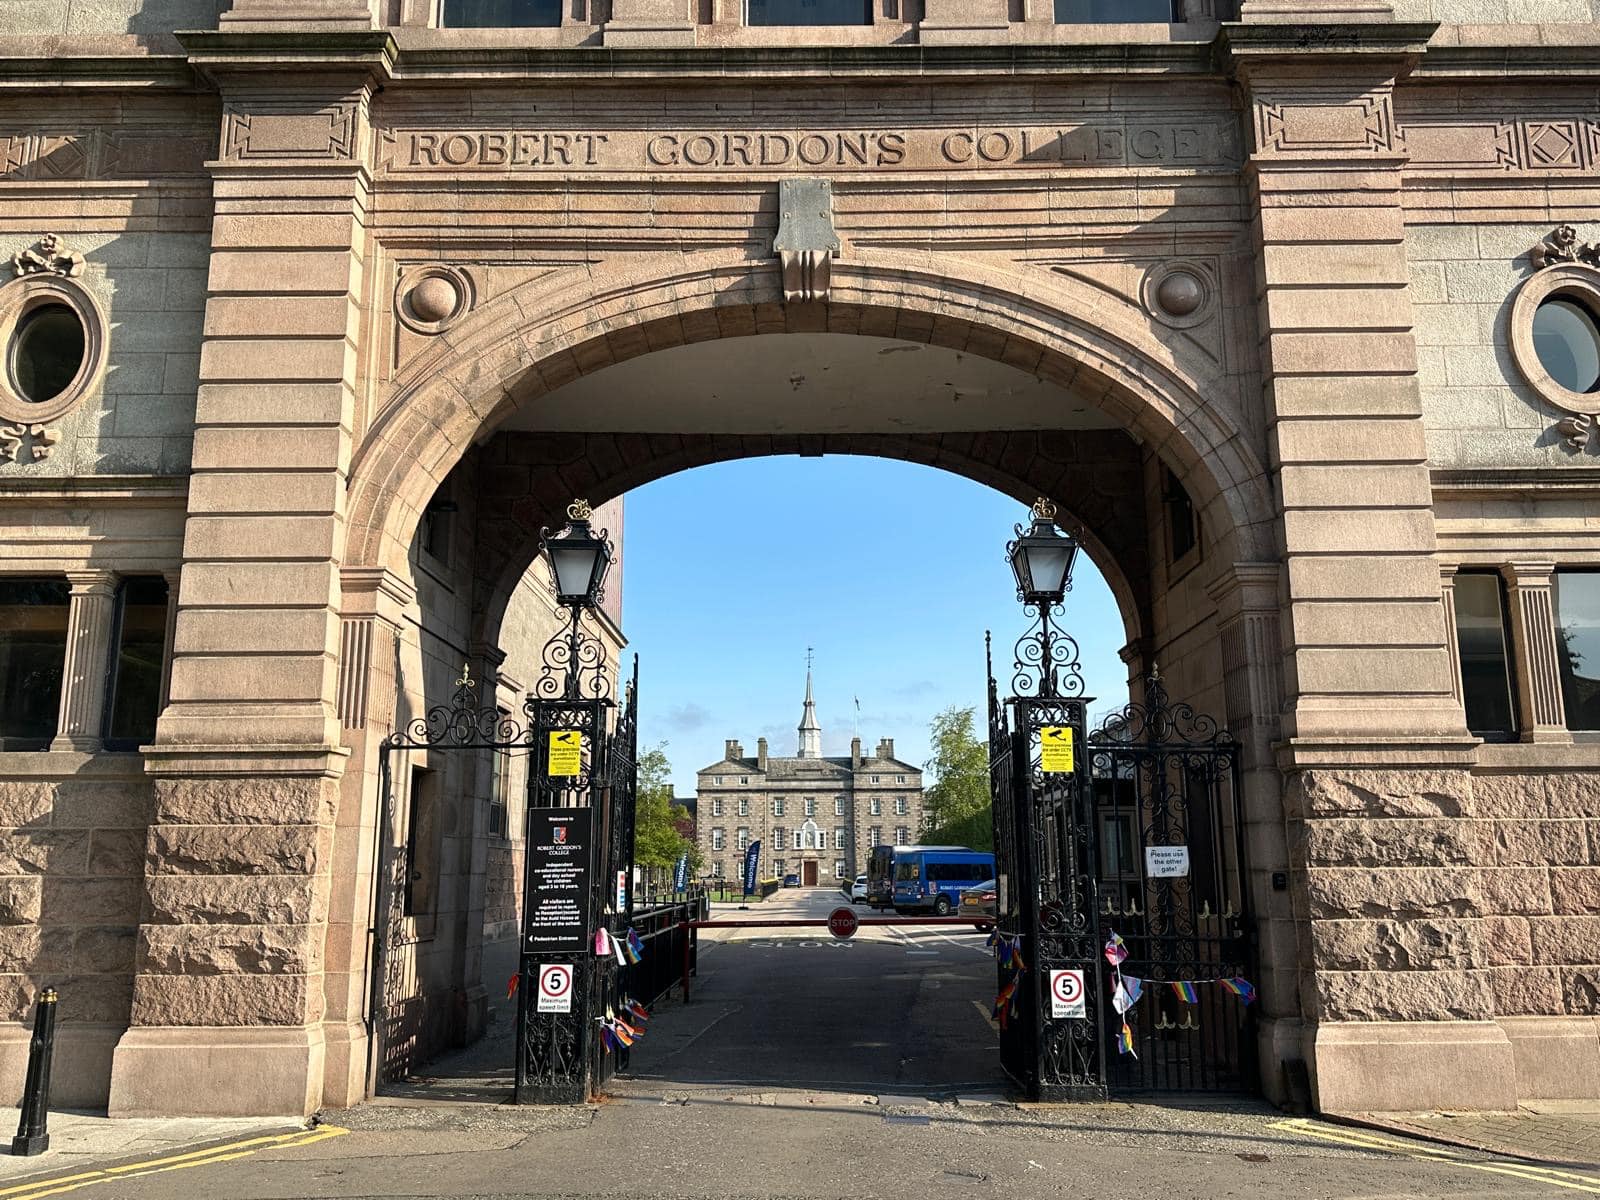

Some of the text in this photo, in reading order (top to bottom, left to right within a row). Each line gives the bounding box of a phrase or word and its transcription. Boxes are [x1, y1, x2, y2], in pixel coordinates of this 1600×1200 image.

[409, 129, 1202, 166] ROBERT GORDON'S COLLEGE
[748, 854, 758, 888] Welcome
[831, 919, 855, 928] STOP
[550, 973, 561, 990] 5
[1062, 979, 1073, 996] 5
